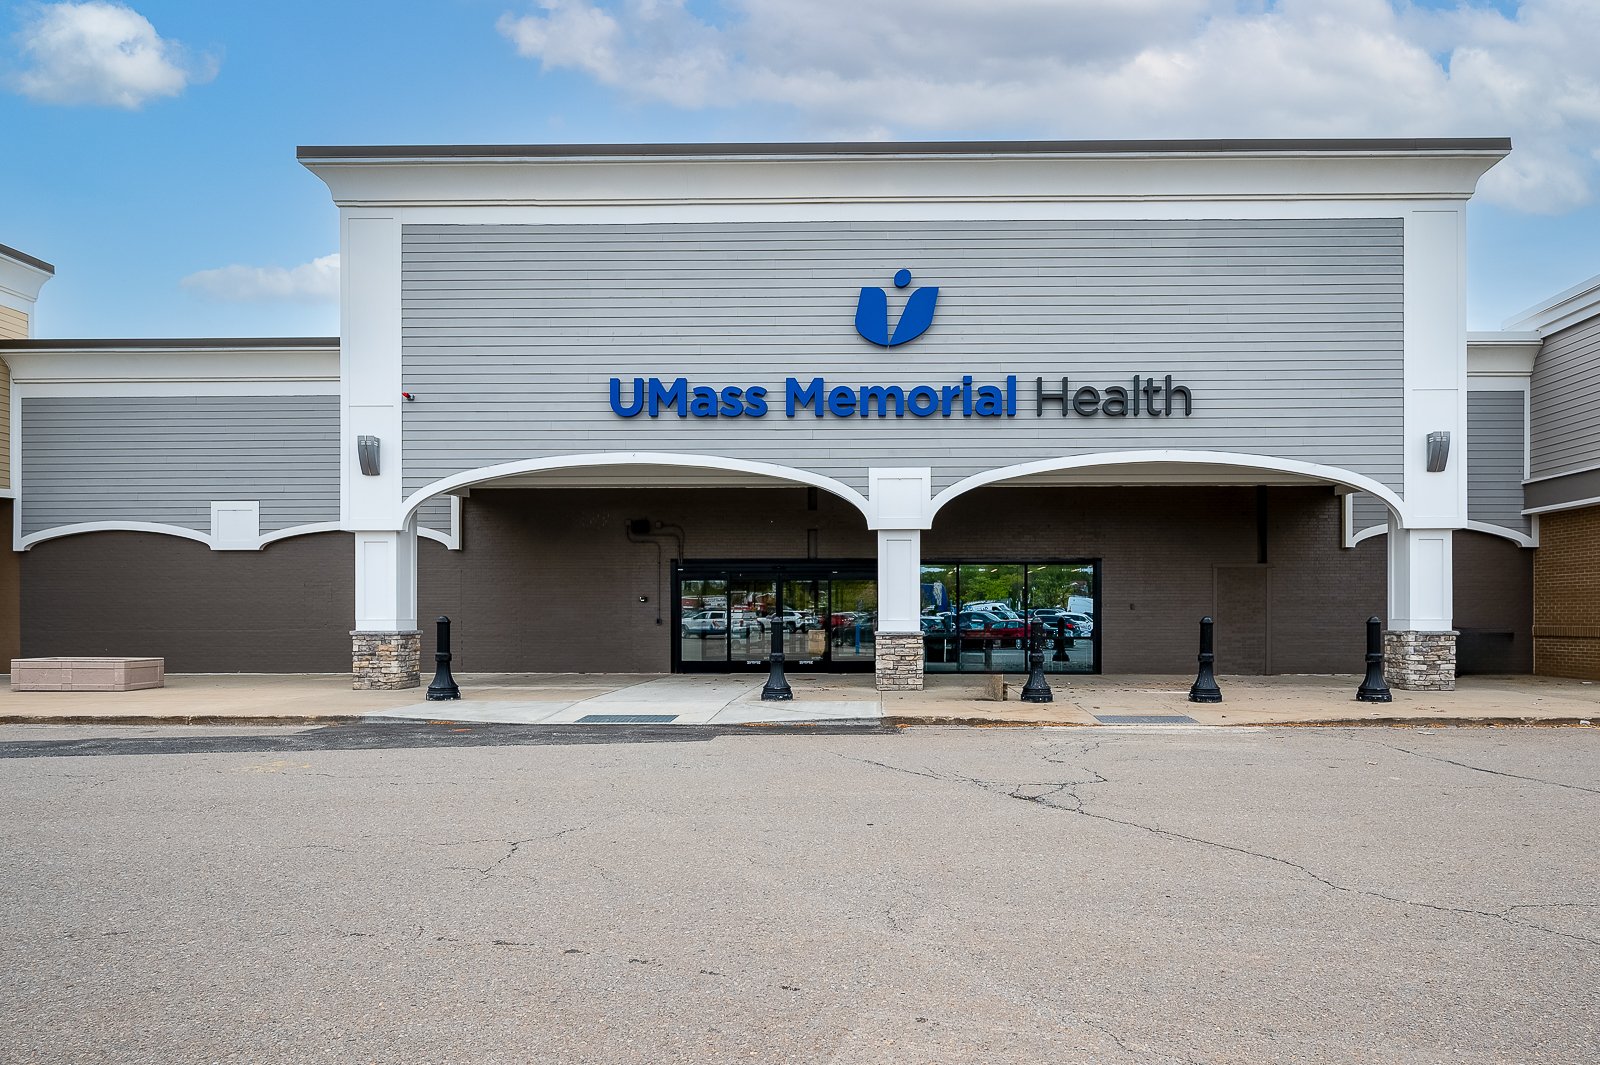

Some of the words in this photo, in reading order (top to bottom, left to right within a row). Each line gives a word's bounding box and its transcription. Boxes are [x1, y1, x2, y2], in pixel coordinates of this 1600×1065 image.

[609, 377, 768, 418] UMass
[785, 375, 1016, 418] Memorial
[1036, 374, 1193, 417] Health
